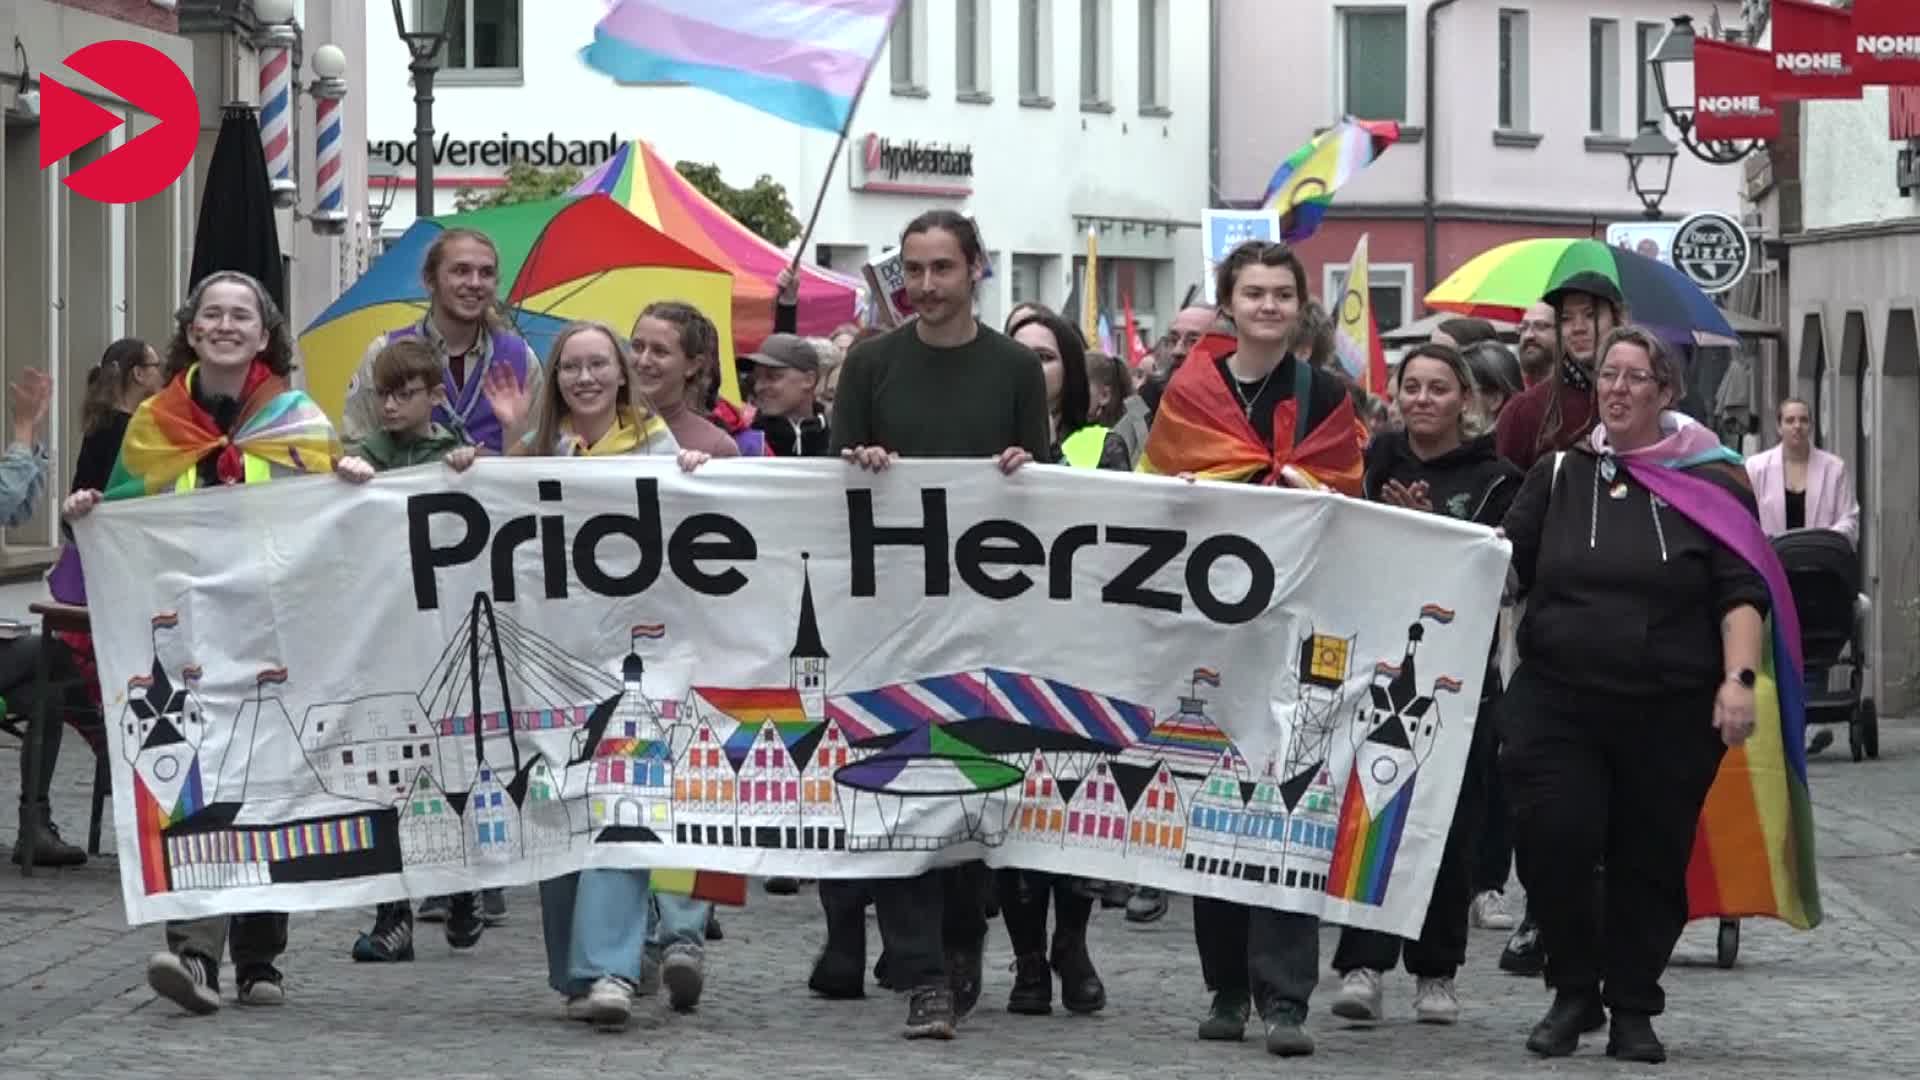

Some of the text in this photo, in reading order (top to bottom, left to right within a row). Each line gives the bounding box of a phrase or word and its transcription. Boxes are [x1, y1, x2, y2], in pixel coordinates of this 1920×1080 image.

[1776, 53, 1842, 69] NOHE
[1699, 96, 1760, 112] NOHE
[1682, 246, 1737, 260] PIZZA
[407, 477, 1276, 625] Pride Herzo
